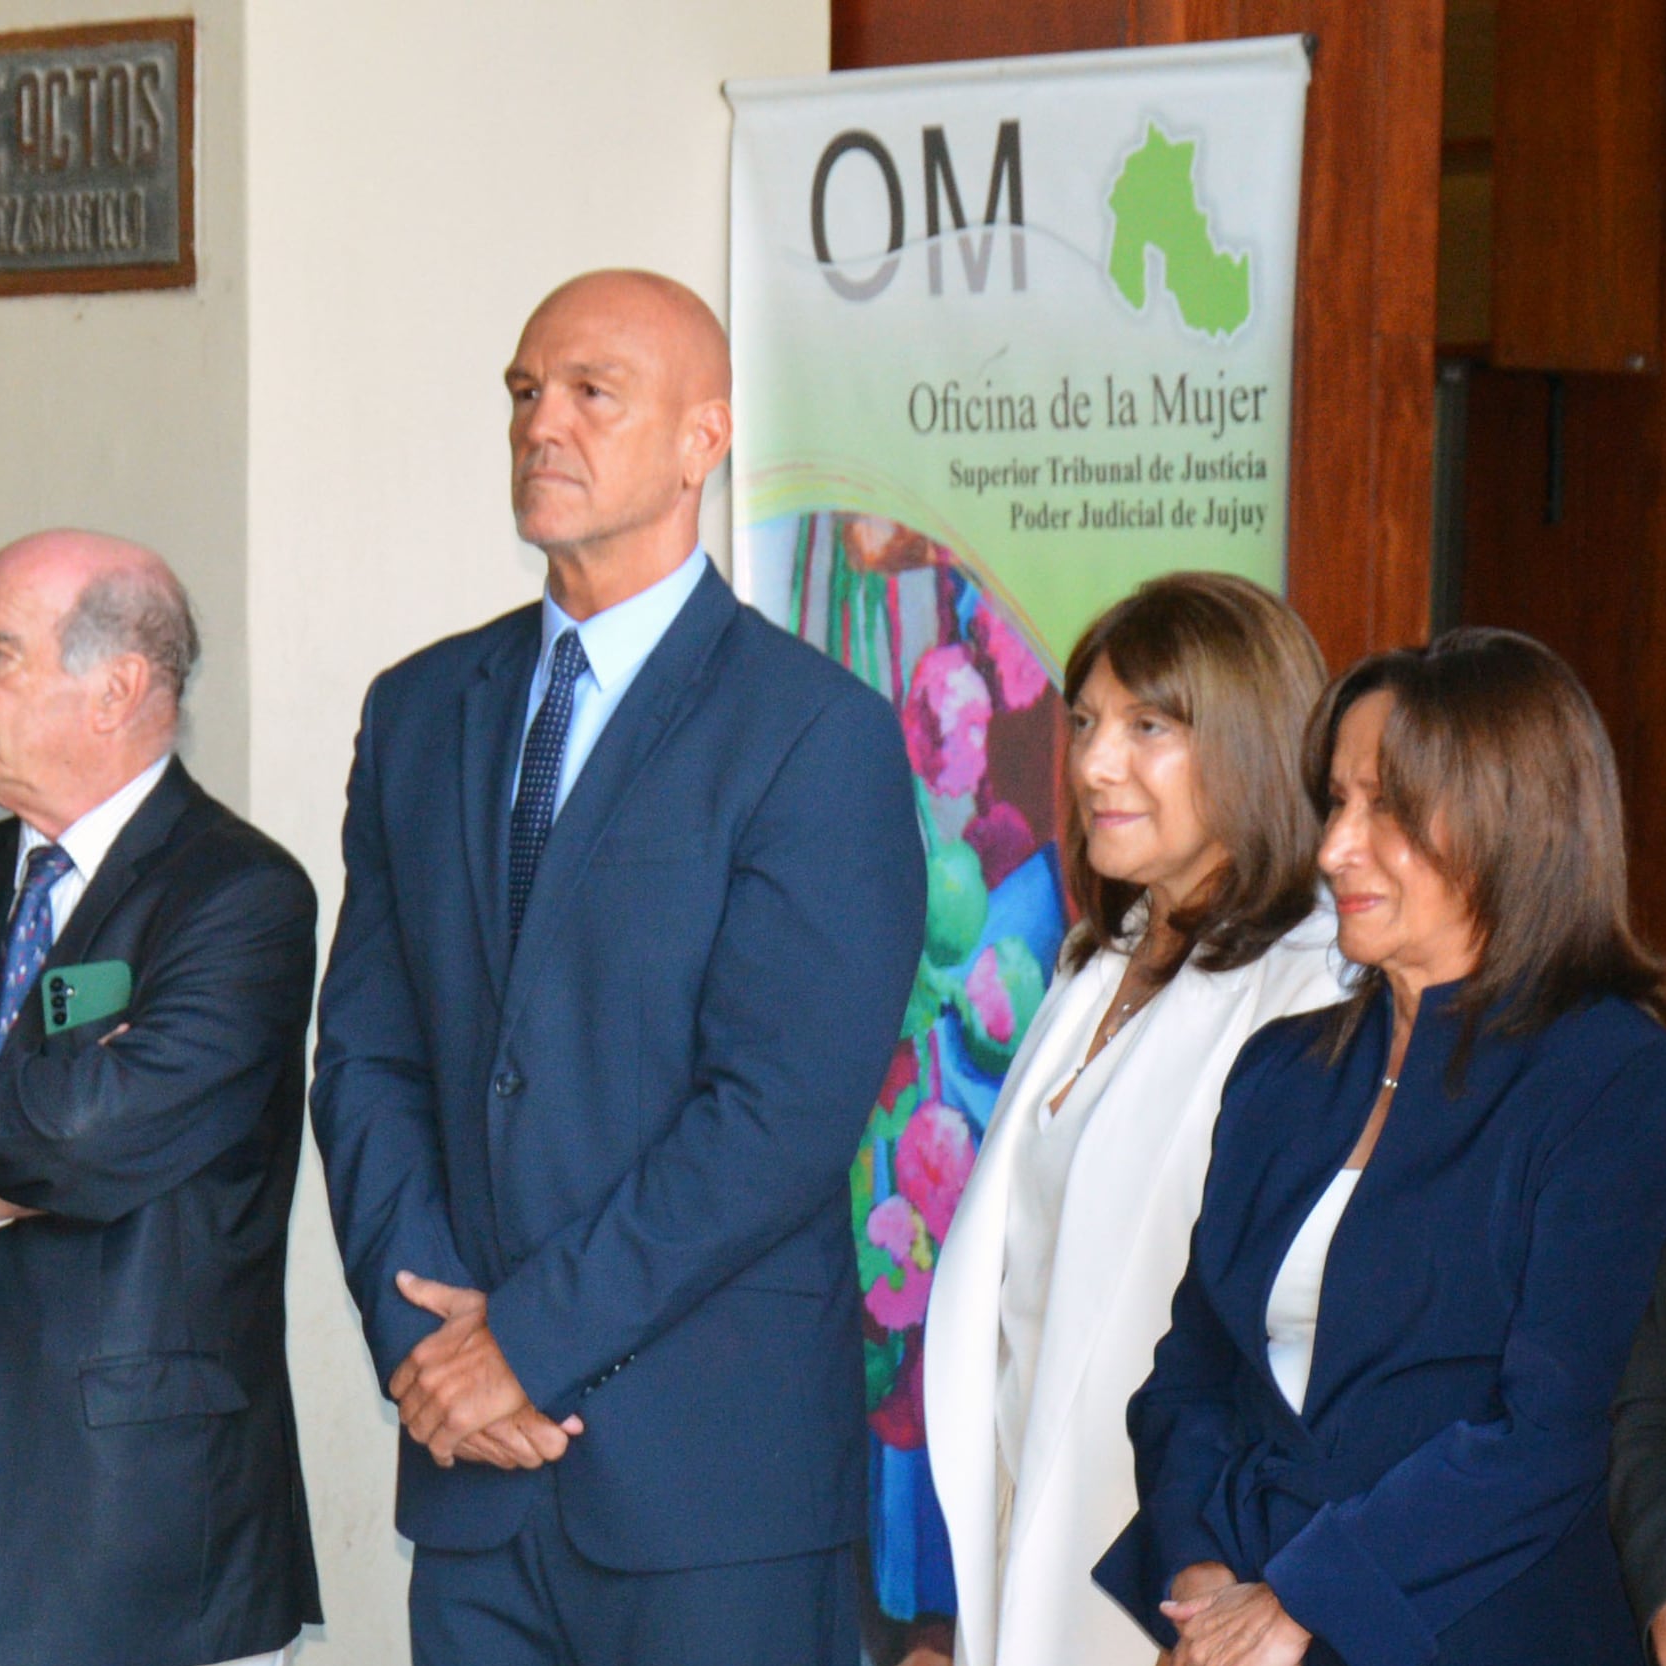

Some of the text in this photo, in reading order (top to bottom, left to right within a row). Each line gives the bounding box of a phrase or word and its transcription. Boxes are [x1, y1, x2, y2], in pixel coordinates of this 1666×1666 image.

[810, 118, 1028, 302] OM
[908, 369, 1268, 440] Oficina de la Mujer
[949, 451, 1269, 495] Superior Tribunal de Justicia
[1010, 498, 1269, 535] Poder Judicial de Jujuy
